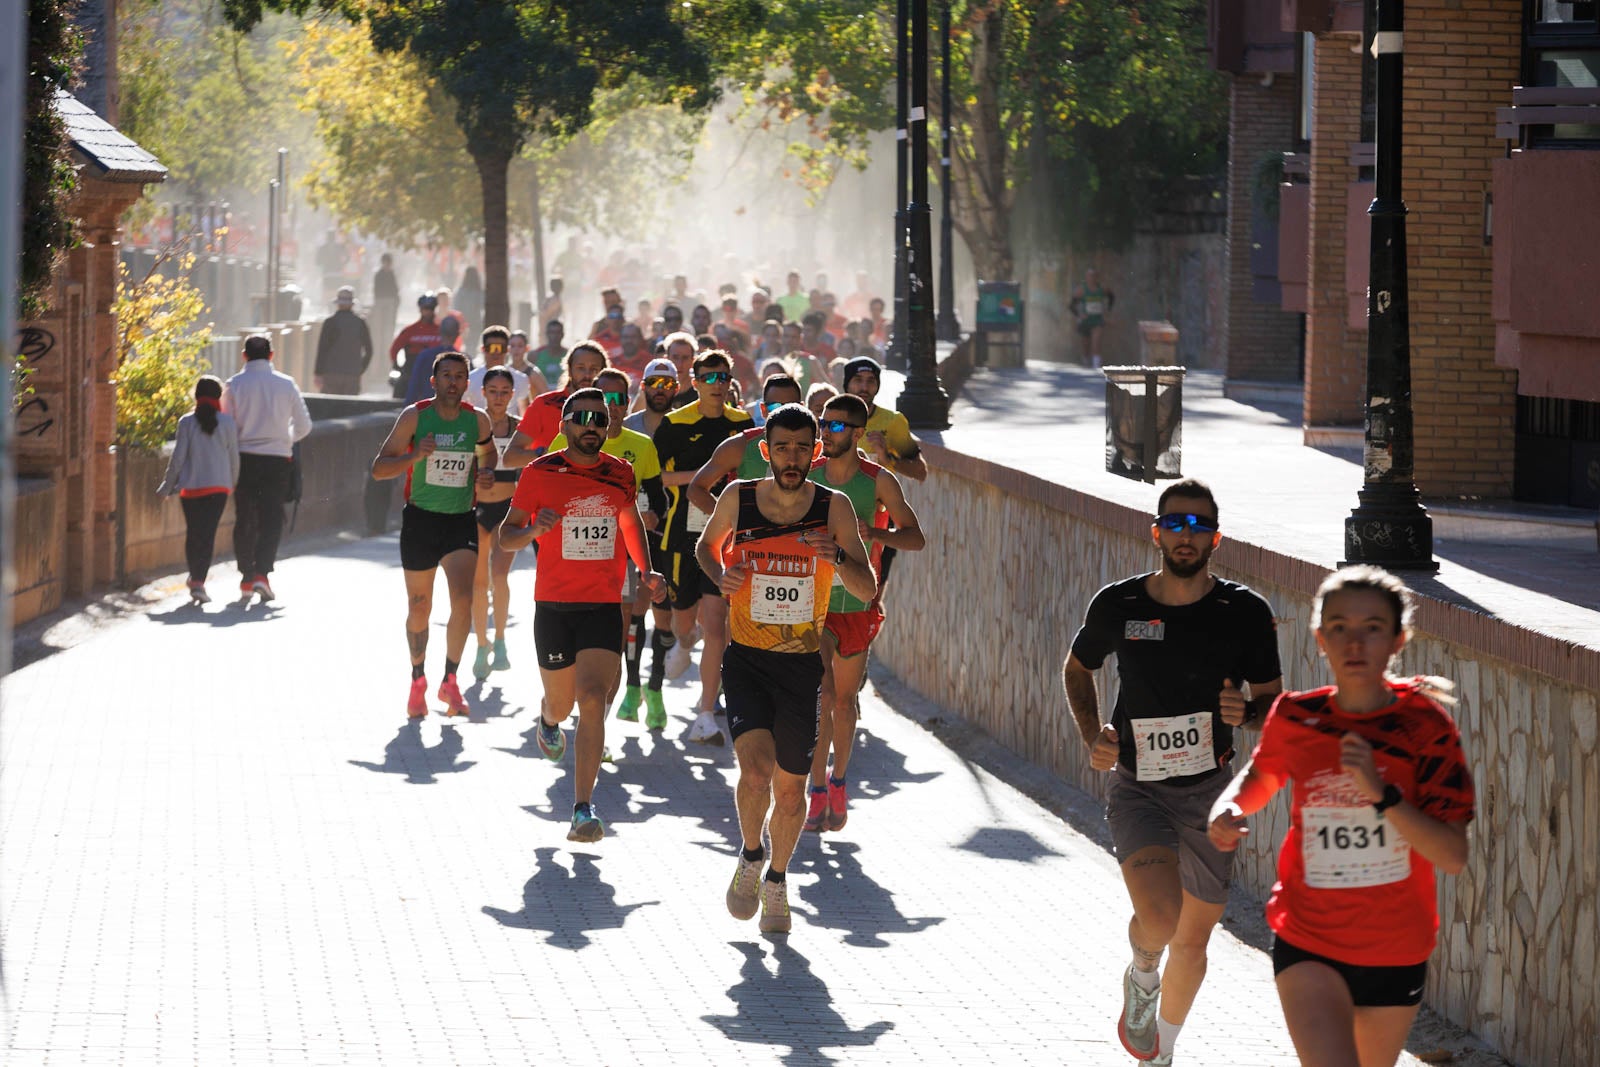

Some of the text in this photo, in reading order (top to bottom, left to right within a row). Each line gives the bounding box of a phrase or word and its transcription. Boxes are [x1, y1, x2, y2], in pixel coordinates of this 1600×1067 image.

[434, 459, 466, 471] 1270
[566, 507, 614, 517] carrera
[572, 526, 609, 540] 1132
[747, 550, 809, 563] Club Deportivo
[767, 556, 817, 575] ZUBIA
[765, 586, 799, 602] 890
[1126, 620, 1164, 640] BERLIN
[1146, 727, 1200, 751] 1080
[1162, 751, 1189, 760] ROBERTO
[1317, 824, 1387, 850] 1631
